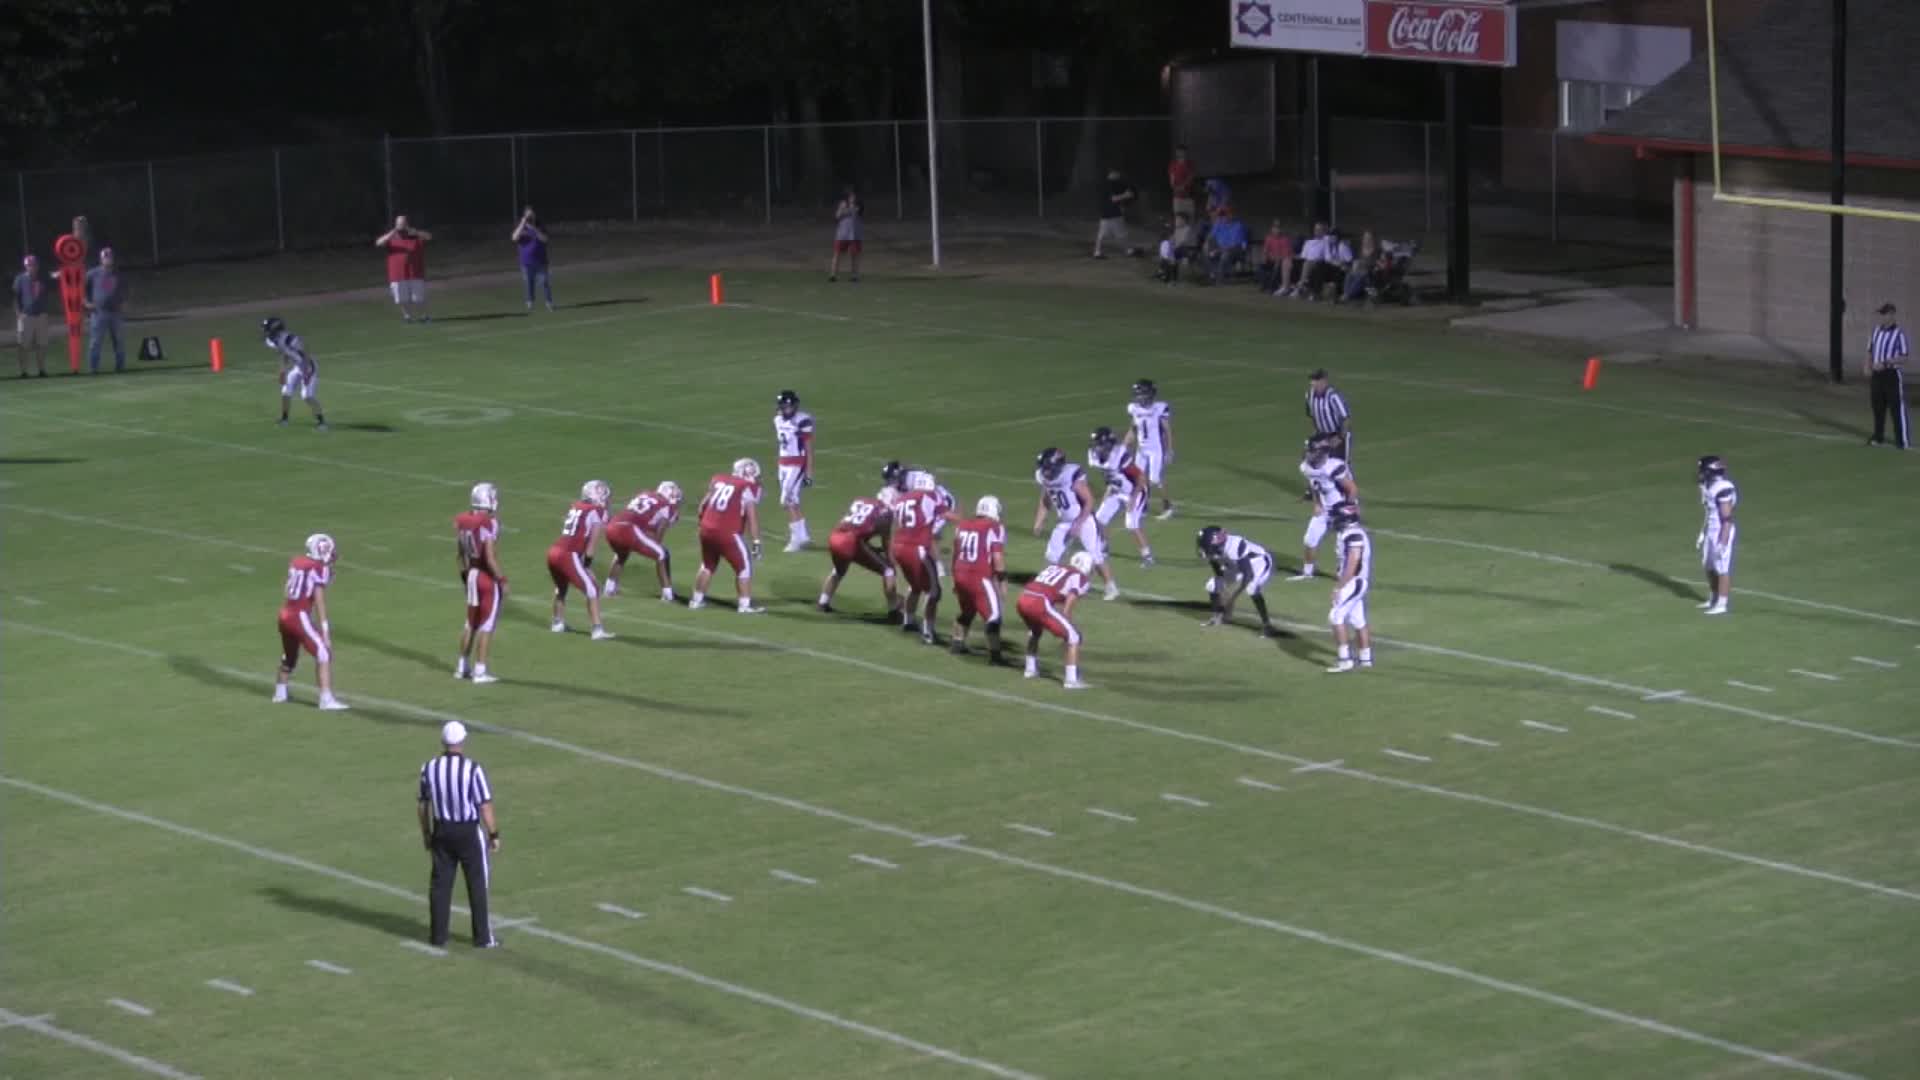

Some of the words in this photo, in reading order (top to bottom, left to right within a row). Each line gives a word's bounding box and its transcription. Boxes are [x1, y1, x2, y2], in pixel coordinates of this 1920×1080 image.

[709, 481, 735, 512] 78
[895, 499, 921, 528] 75
[959, 530, 979, 562] 70
